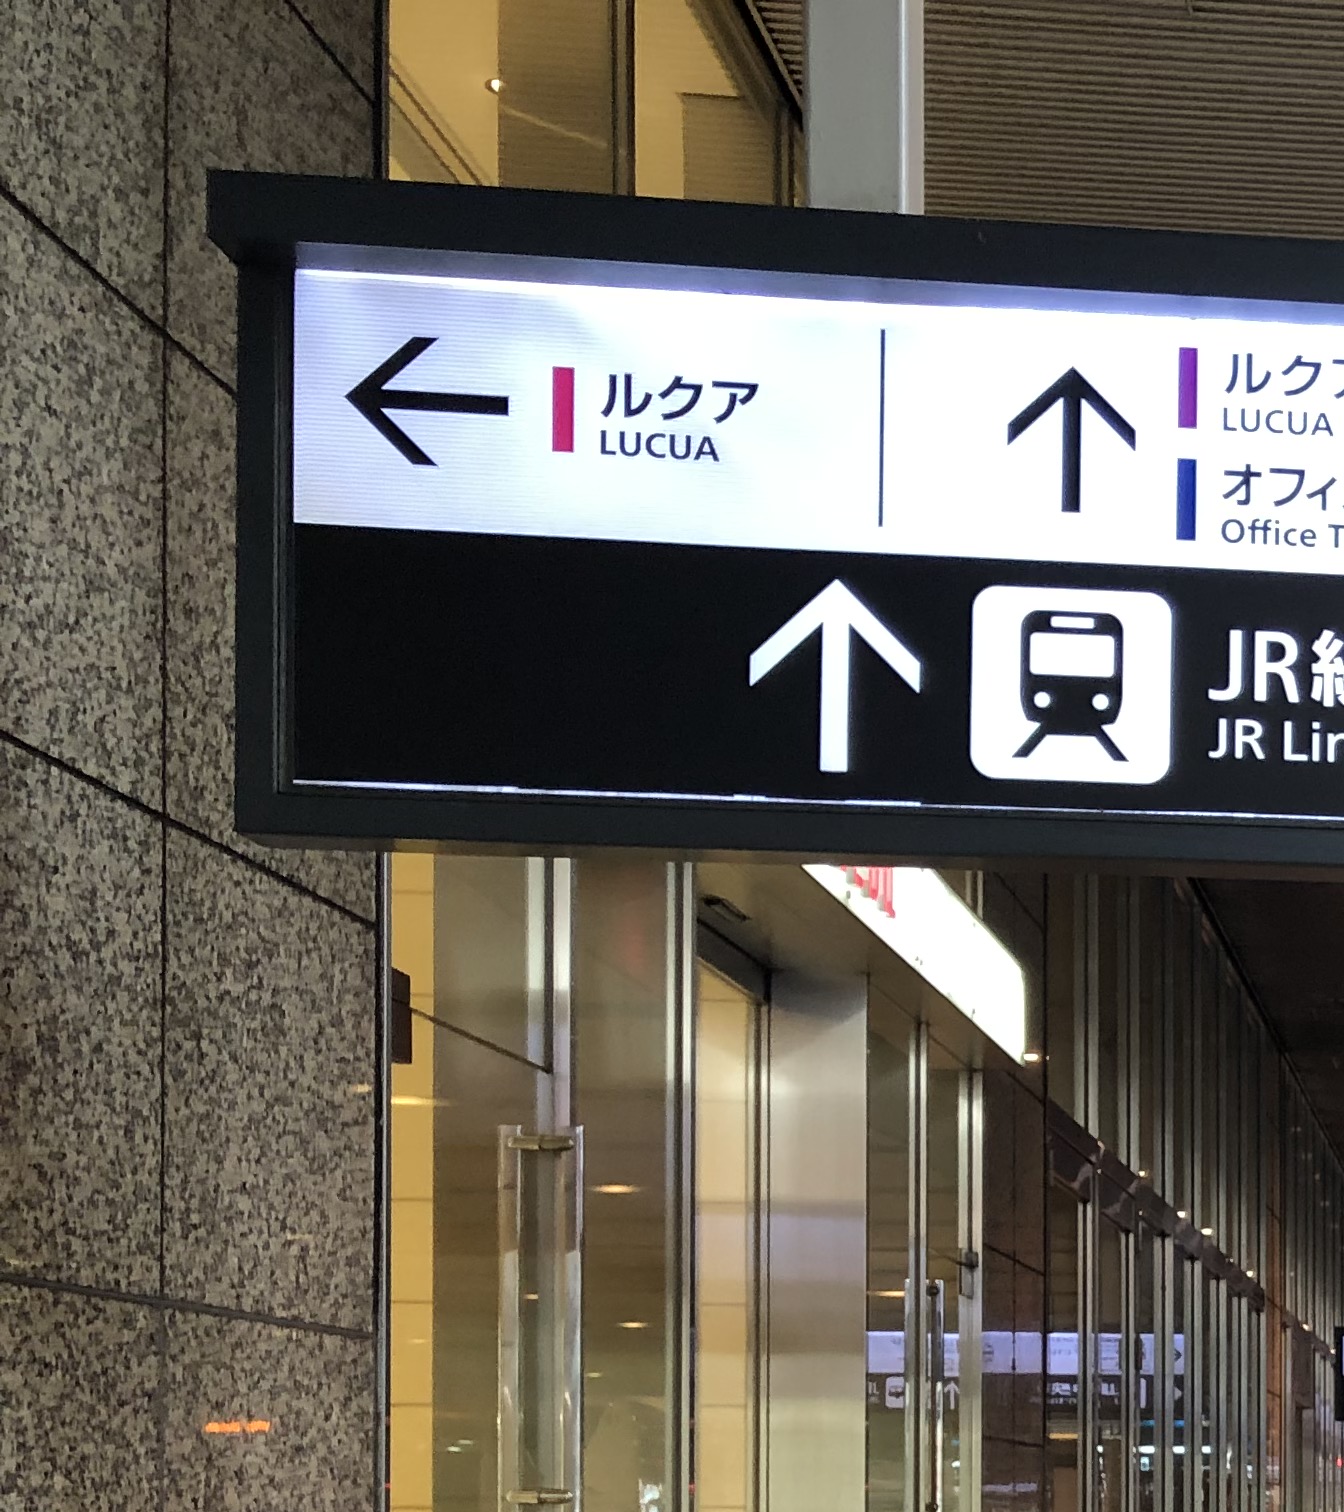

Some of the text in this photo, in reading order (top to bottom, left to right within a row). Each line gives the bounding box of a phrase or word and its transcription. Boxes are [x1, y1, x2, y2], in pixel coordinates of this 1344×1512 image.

[599, 373, 760, 424] ルクア
[1222, 408, 1334, 438] LUCUA
[599, 429, 721, 463] LUCUA
[1220, 518, 1319, 550] Office
[1208, 717, 1266, 762] JR
